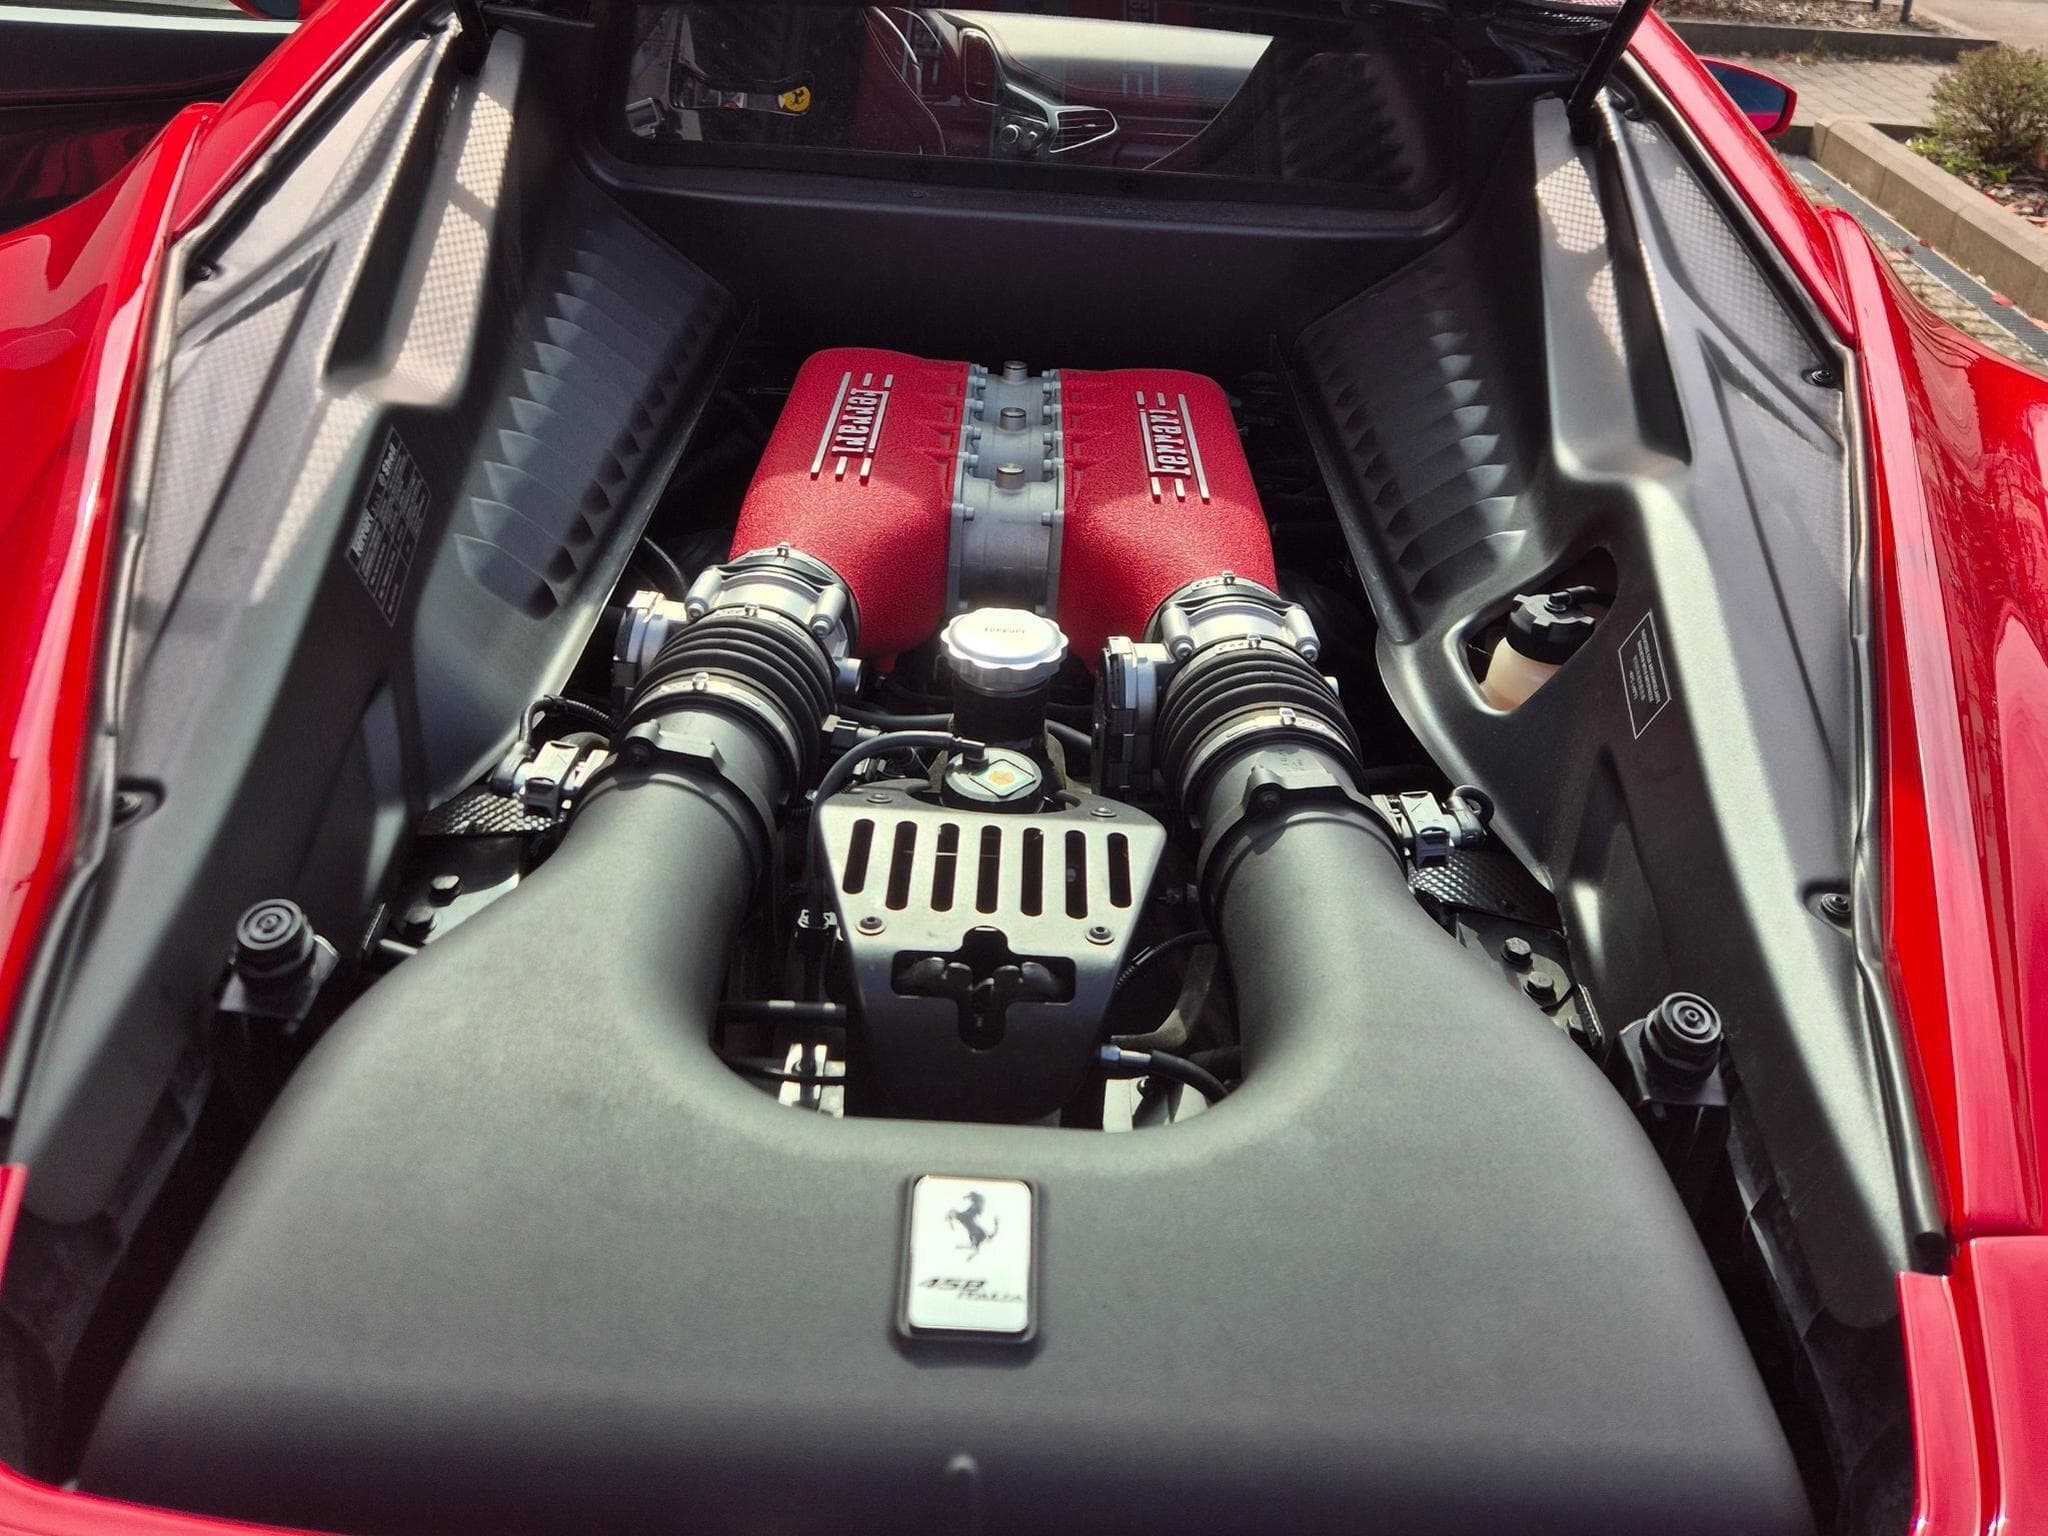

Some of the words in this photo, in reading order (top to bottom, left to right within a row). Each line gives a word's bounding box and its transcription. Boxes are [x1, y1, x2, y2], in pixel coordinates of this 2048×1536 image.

[832, 387, 889, 455] Ferrari
[1139, 408, 1191, 477] Ferrari
[919, 1278, 986, 1291] 458
